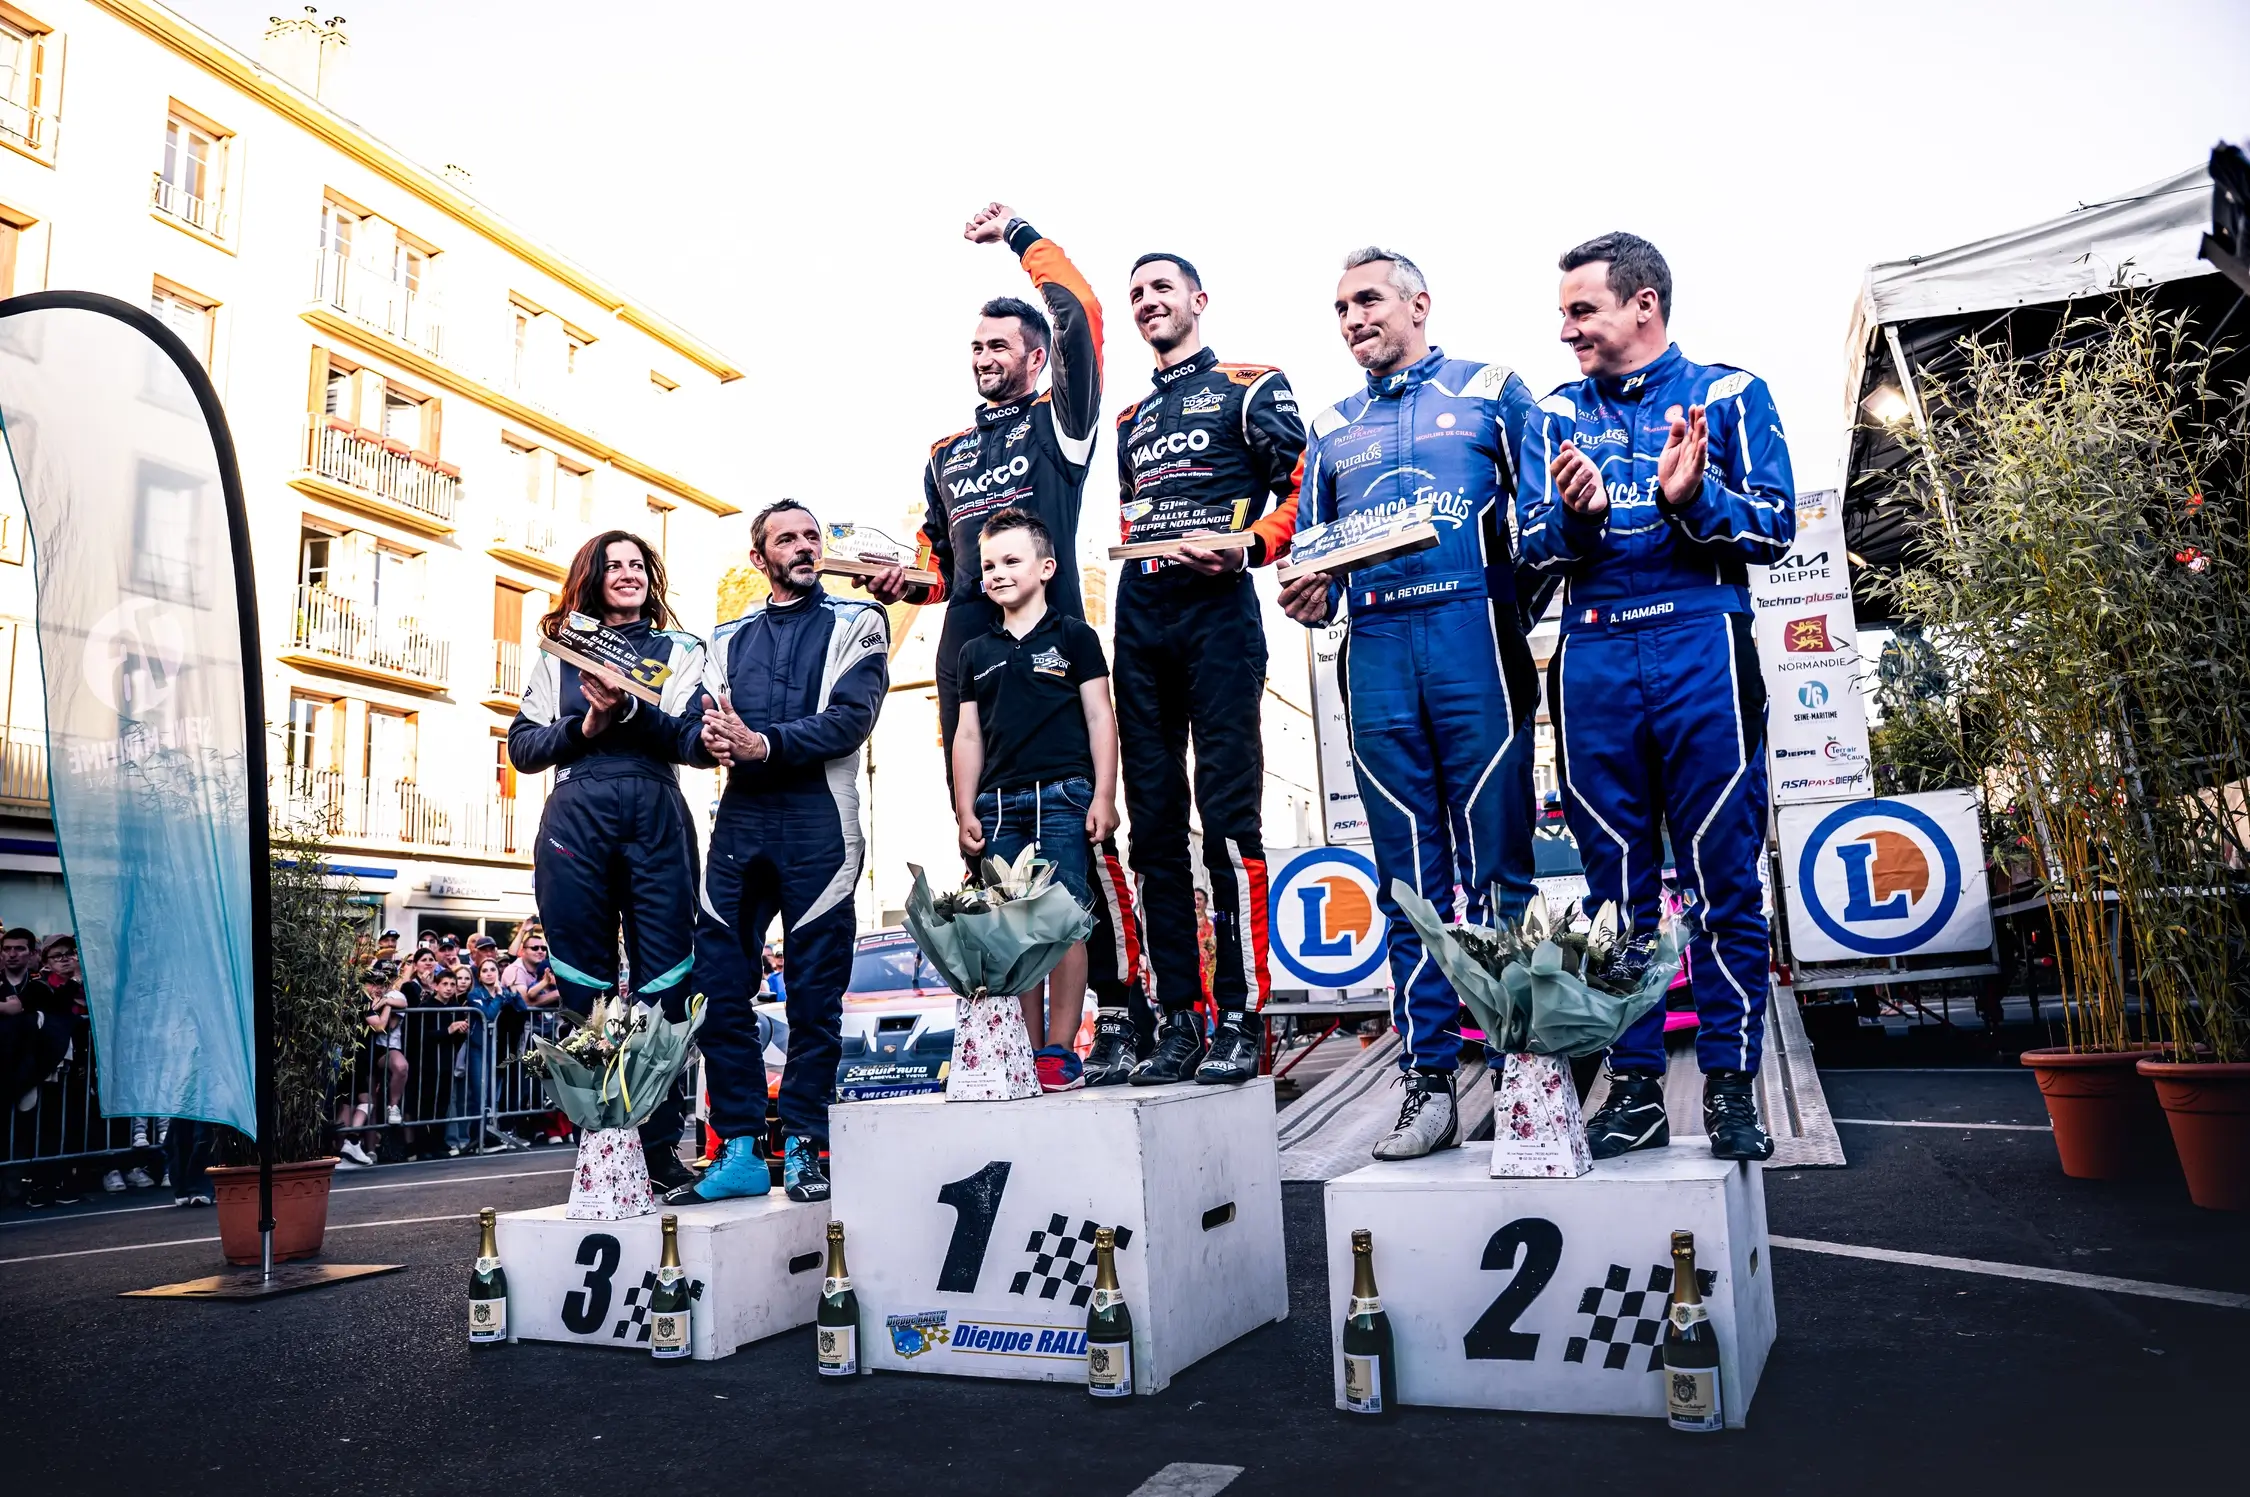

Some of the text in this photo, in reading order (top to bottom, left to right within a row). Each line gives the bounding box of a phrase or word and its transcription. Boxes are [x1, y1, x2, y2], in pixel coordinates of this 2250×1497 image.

[1160, 364, 1196, 384] YACCO
[1183, 394, 1224, 408] COSSON
[985, 406, 1019, 421] YACCO
[1416, 432, 1444, 441] MOULINS
[1131, 429, 1210, 469] YACCO
[1335, 448, 1382, 473] Puratos
[948, 455, 1029, 499] YACCO
[1413, 486, 1473, 520] Frais
[1152, 508, 1207, 522] RALLYE DE
[1229, 498, 1250, 530] 1
[1130, 515, 1232, 533] DIEPPE NORMANDIE
[1159, 560, 1166, 568] K.
[1770, 568, 1830, 584] DIEPPE
[1385, 582, 1459, 602] M. REYDELLET
[1757, 592, 1848, 609] Techno-plus.eu
[1610, 602, 1674, 623] A. HAMARD
[562, 628, 637, 668] DIEPPE NORMANDIE
[590, 635, 638, 662] RALLYE DE
[861, 634, 883, 649] OMP
[1033, 657, 1069, 669] COSSON
[1778, 658, 1846, 672] NORMANDIE
[630, 658, 672, 688] 3
[1800, 683, 1824, 708] 76
[1794, 711, 1838, 722] SEINE-MARITIME
[1776, 749, 1816, 758] DIEPPE
[1330, 793, 1358, 801] DIEPP
[1101, 1024, 1121, 1034] OMP
[857, 1066, 927, 1076] EQUIP'AUTO
[936, 1160, 1012, 1293] 1
[561, 1234, 621, 1334] 3
[1463, 1217, 1563, 1361] 2
[886, 1315, 917, 1328] Dieppe
[917, 1310, 948, 1324] RALLYE
[952, 1324, 1087, 1355] Dieppe RALL
